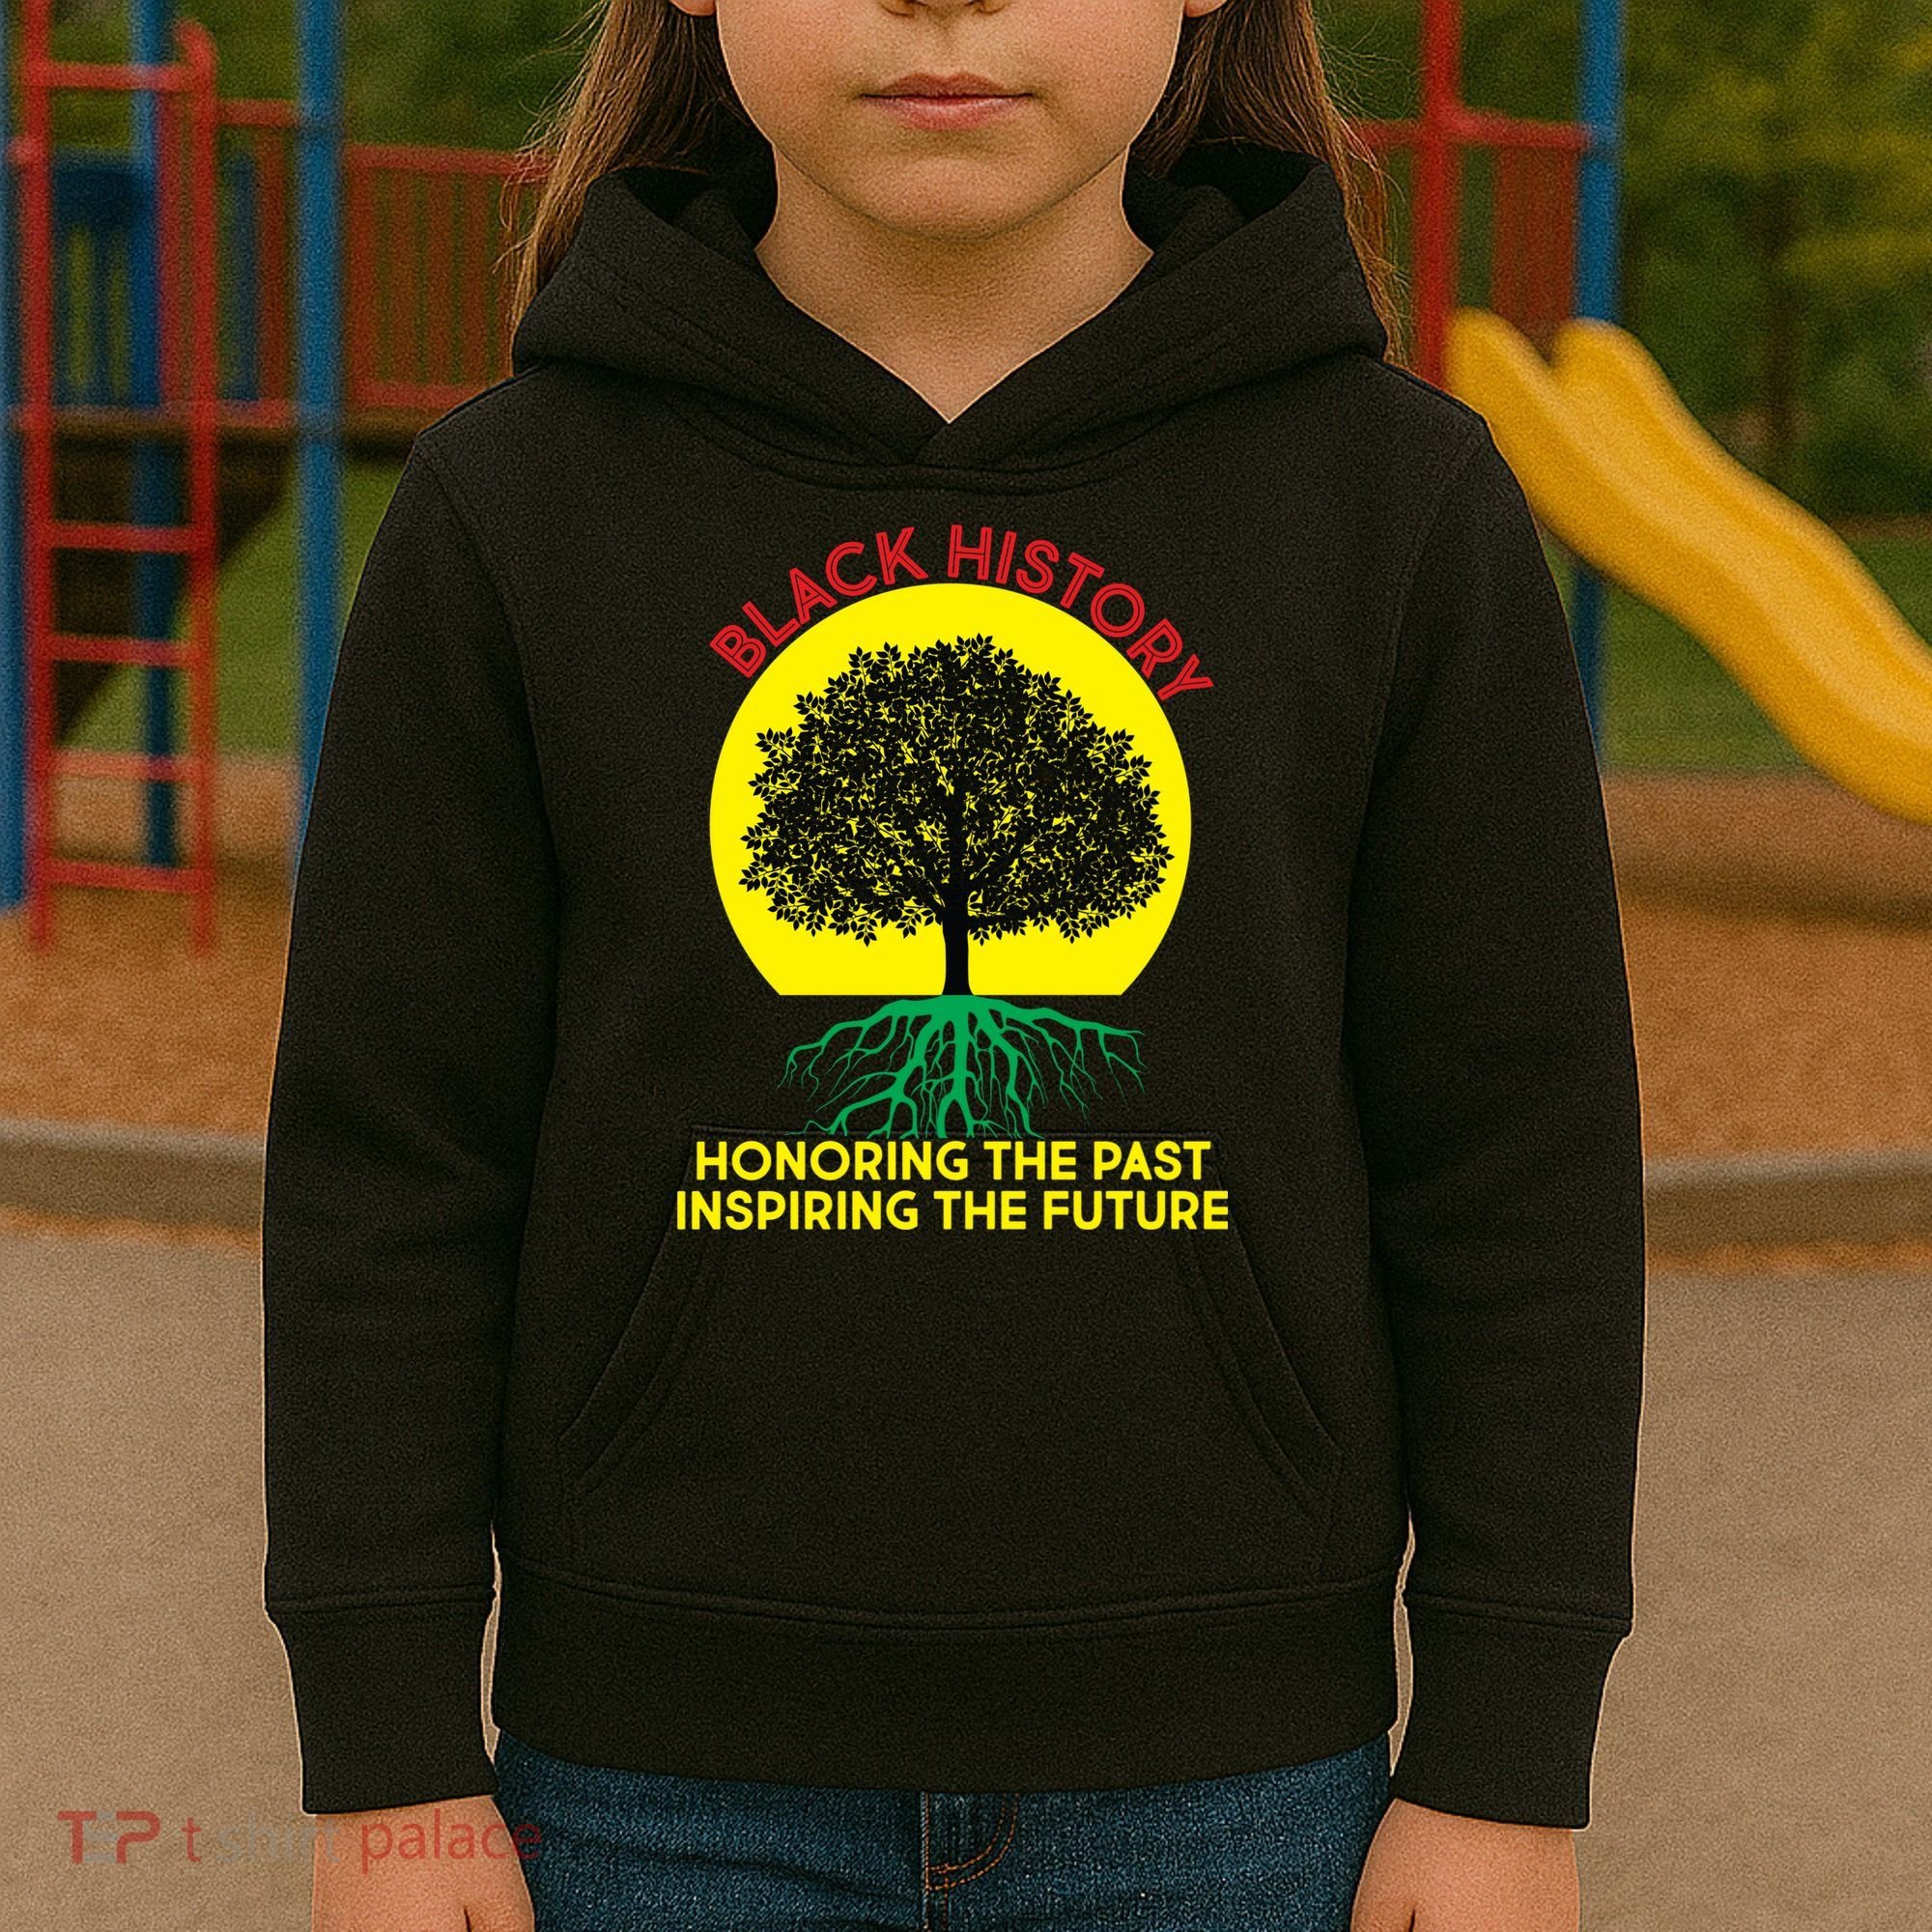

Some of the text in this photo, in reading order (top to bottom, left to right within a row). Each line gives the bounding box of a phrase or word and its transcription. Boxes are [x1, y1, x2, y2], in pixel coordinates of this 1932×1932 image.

[710, 525, 1214, 700] BLACK HISTORY
[696, 1141, 1211, 1180] HONORING THE PAST
[676, 1190, 1229, 1231] INSPIRING THE FUTURE
